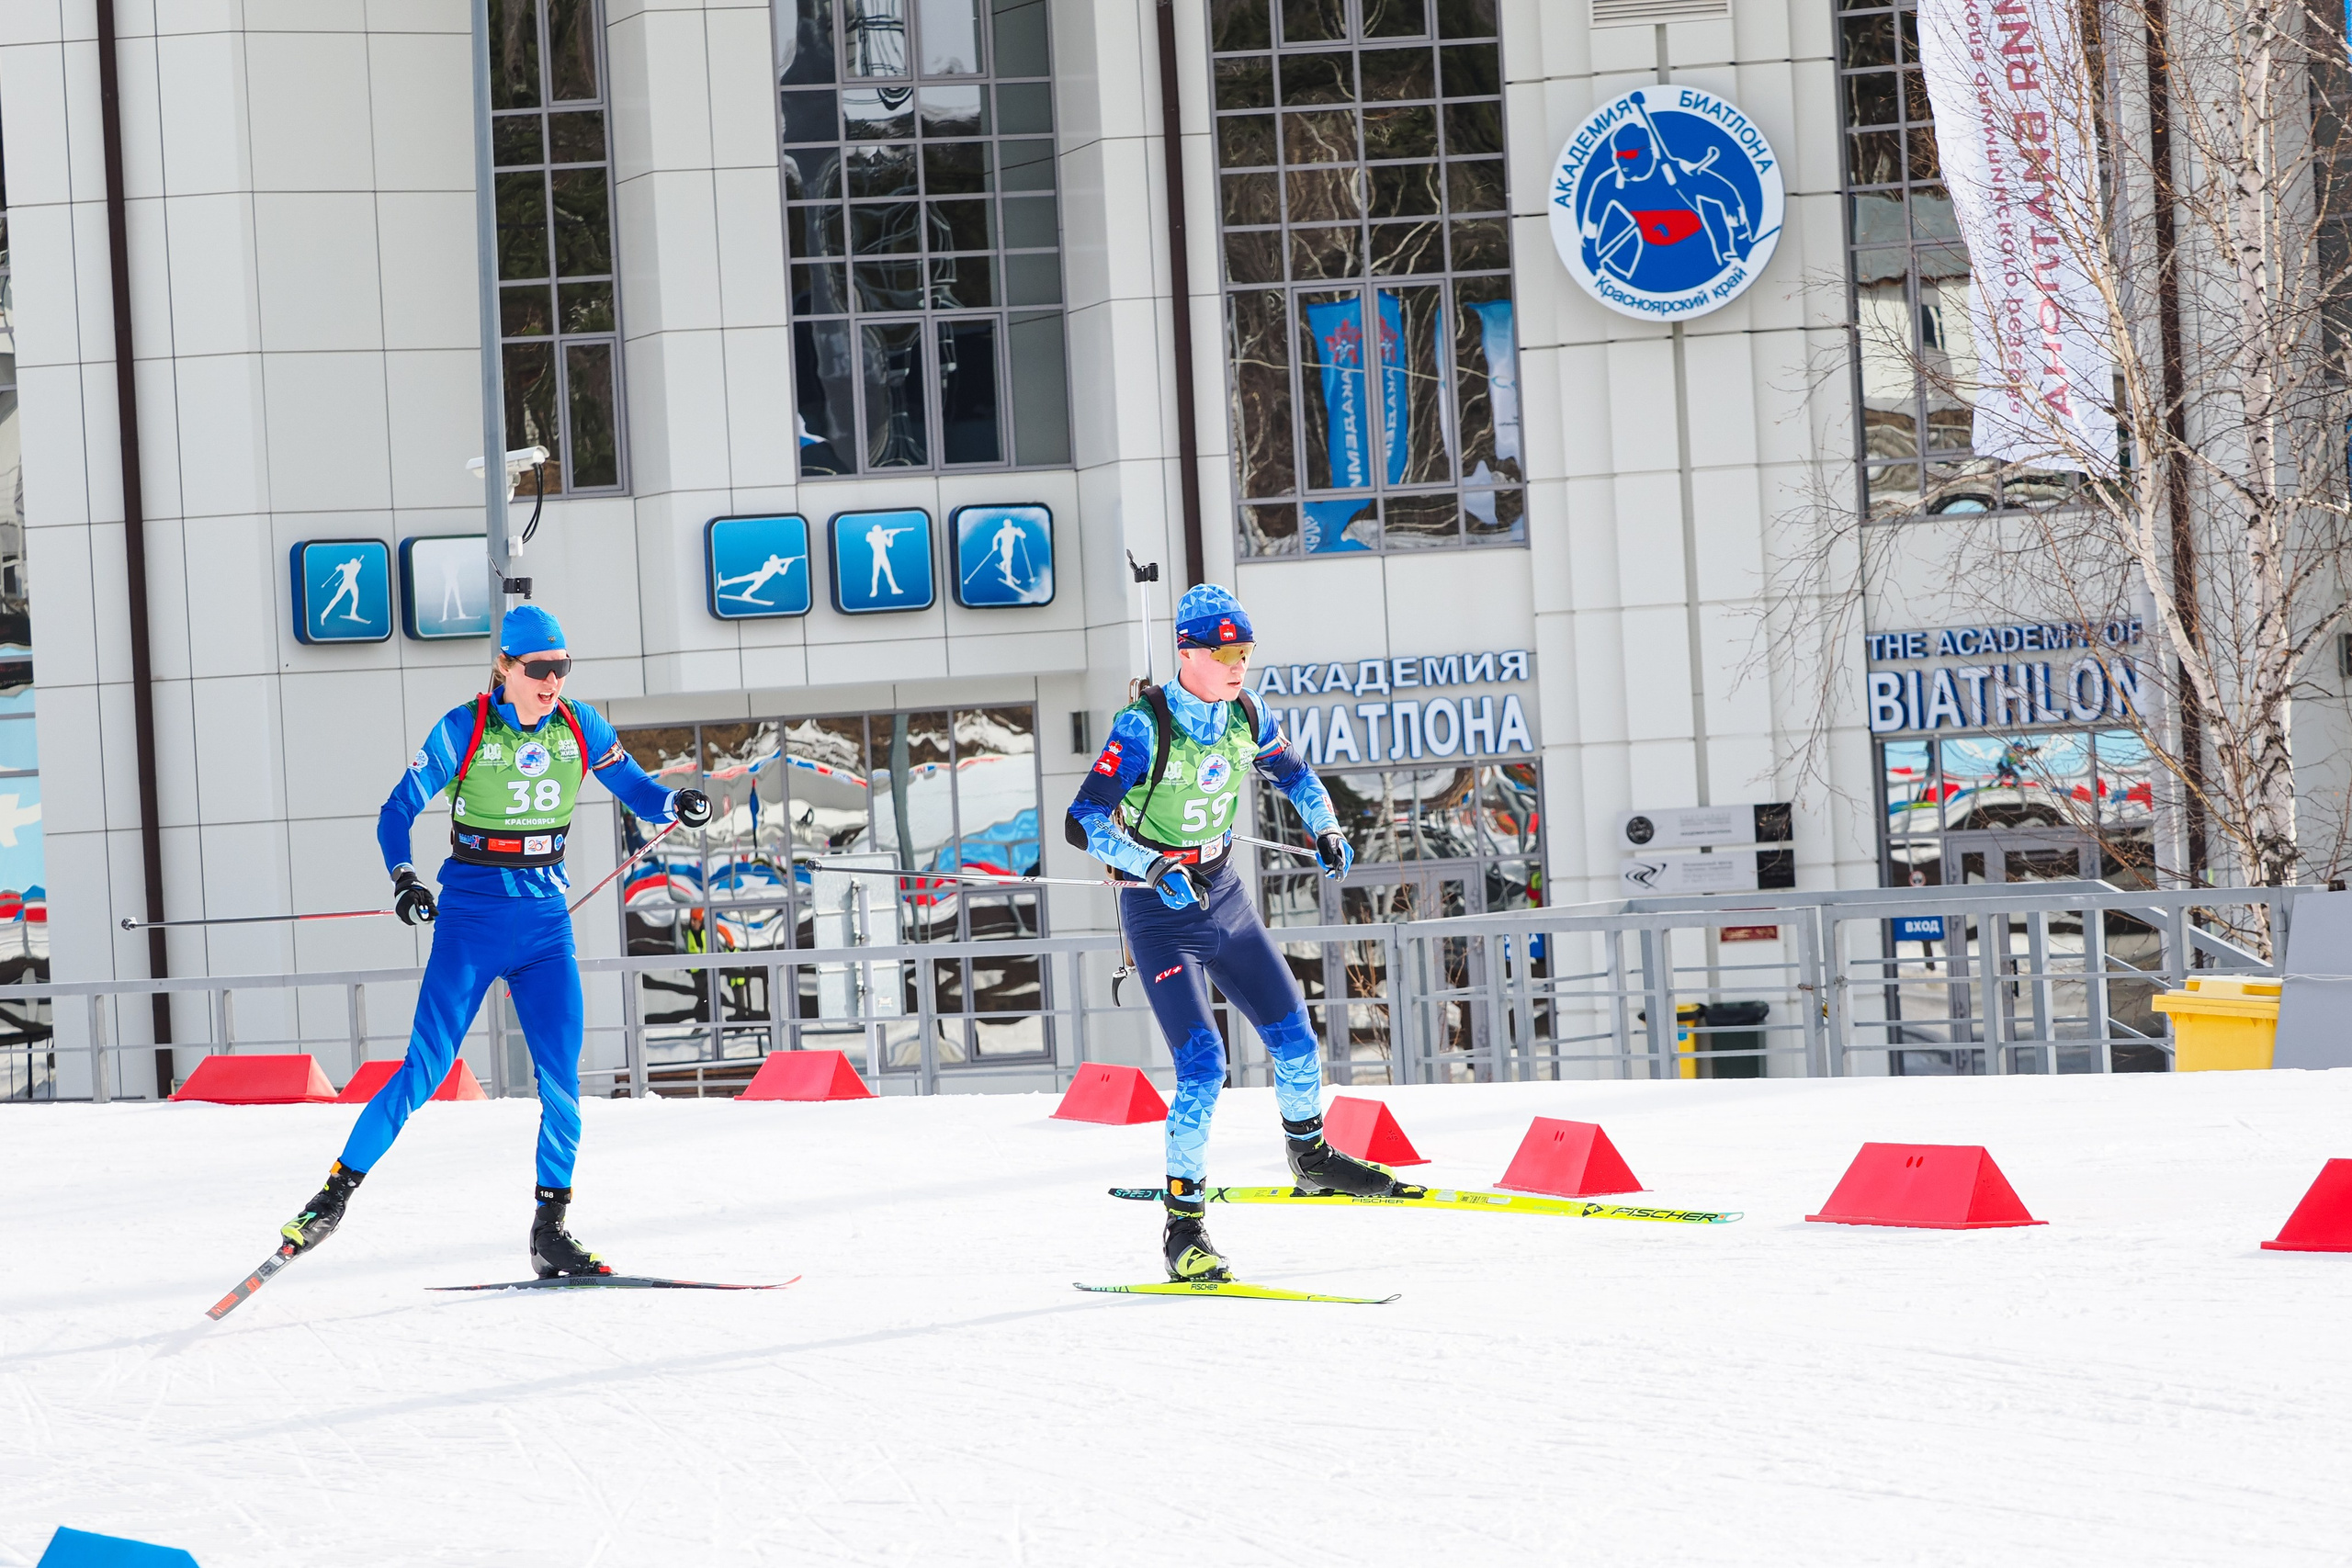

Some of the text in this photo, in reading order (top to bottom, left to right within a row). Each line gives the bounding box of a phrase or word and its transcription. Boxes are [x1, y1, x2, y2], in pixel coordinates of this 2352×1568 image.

[1554, 90, 1774, 209] АКАДЕМИЯ БИАТЛОНА
[1594, 266, 1747, 316] Красноярский край
[1866, 617, 2143, 660] THE ACADEMY OF
[1257, 649, 1530, 697] АКАДЕМИЯ
[1868, 656, 2147, 733] BIATHLON
[1272, 694, 1534, 766] ИАТЛОНА
[504, 778, 562, 816] 38
[1181, 790, 1235, 833] 59
[504, 818, 556, 826] КРАСНОЯРСК
[1905, 919, 1940, 933] ВХОД
[540, 1190, 554, 1199] 188
[1114, 1189, 1153, 1198] SPEED
[1611, 1207, 1719, 1224] FISCHER
